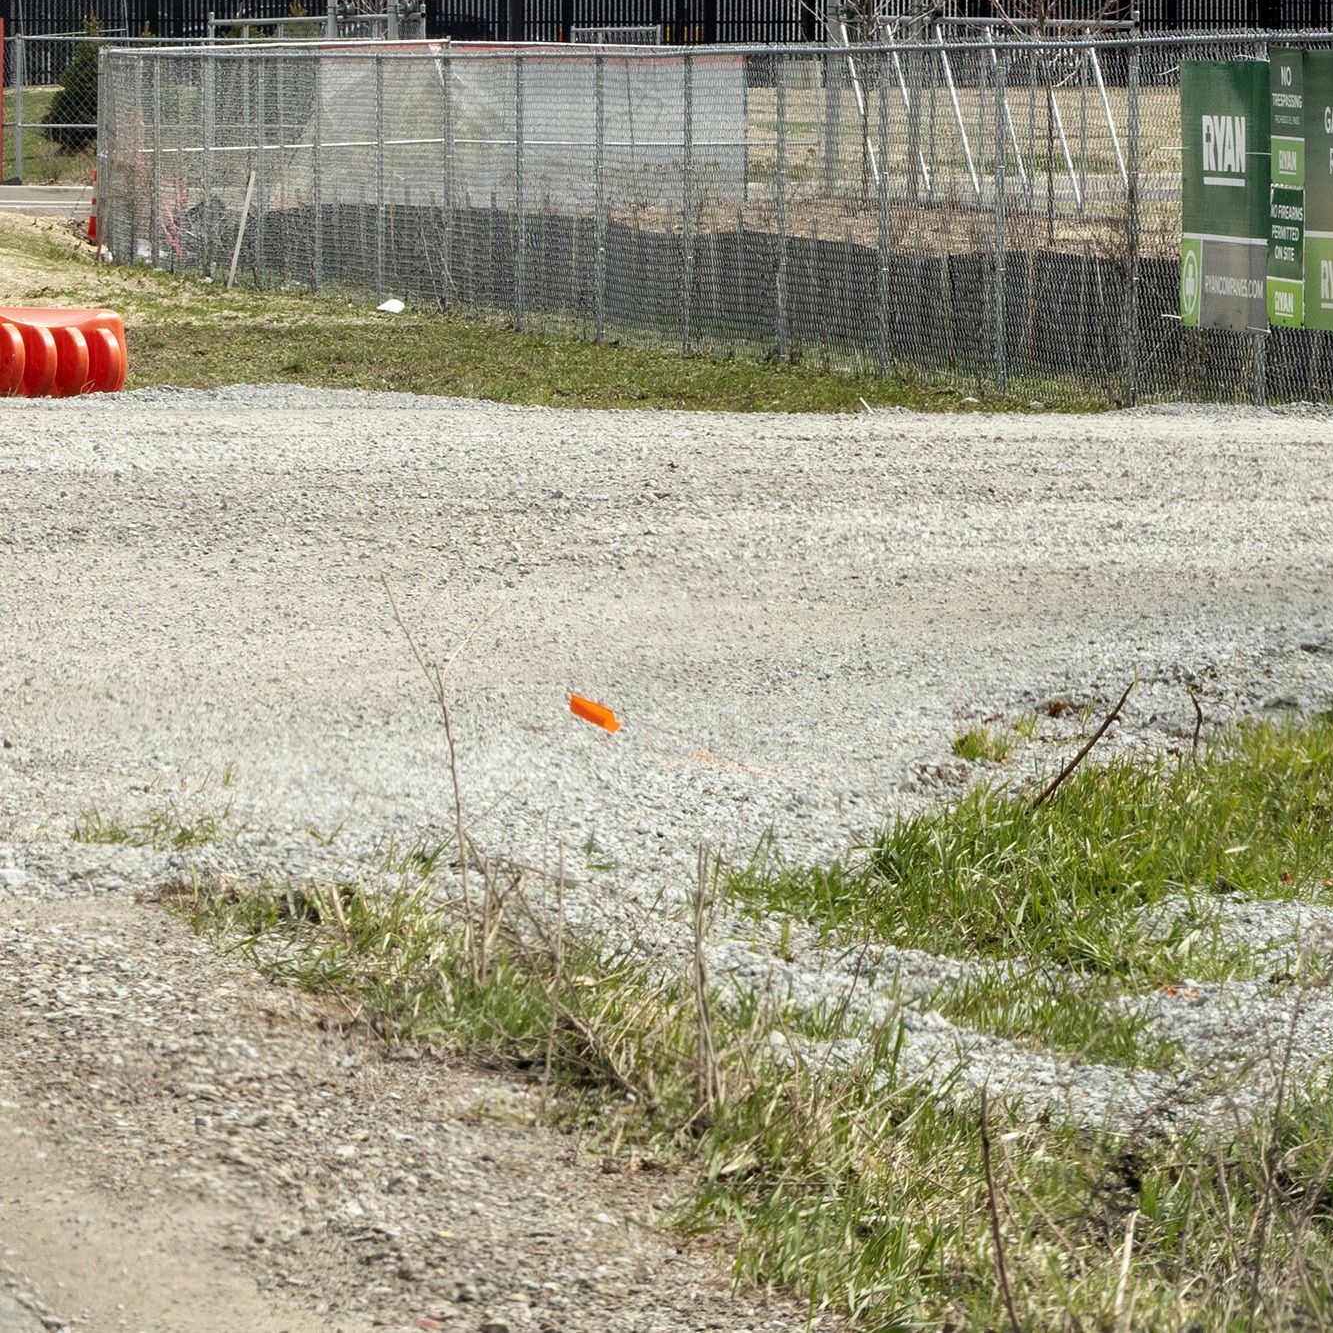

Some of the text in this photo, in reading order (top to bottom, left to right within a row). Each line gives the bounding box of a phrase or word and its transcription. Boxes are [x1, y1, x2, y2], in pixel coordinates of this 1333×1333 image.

[1280, 66, 1292, 87] NO
[1271, 93, 1303, 108] TRESPASSING
[1202, 115, 1246, 173] RYAN
[1279, 150, 1297, 171] RYAN
[1270, 204, 1303, 221] NO FIREARMS
[1271, 224, 1299, 241] PERMITTED
[1274, 247, 1295, 261] ON SITE
[1274, 292, 1293, 313] RYAN
